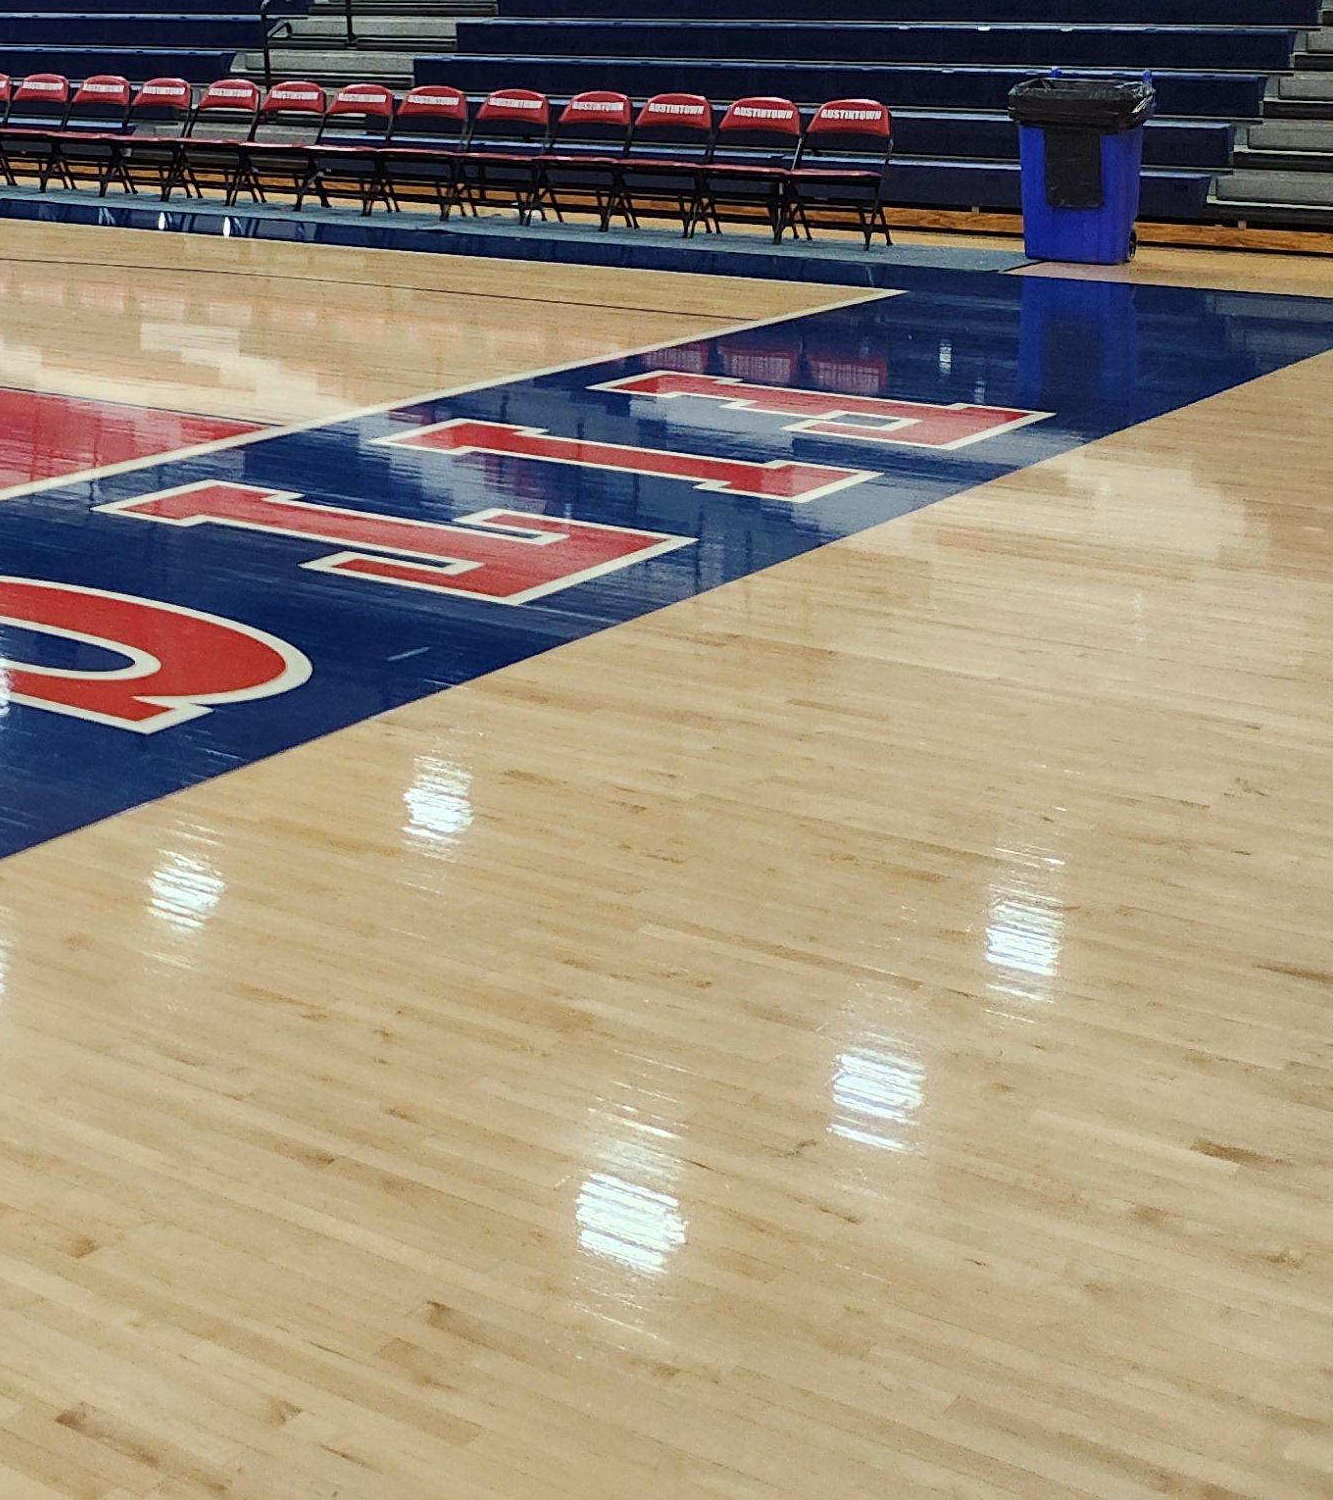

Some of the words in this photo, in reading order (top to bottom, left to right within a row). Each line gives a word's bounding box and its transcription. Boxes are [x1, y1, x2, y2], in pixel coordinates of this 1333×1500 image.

[648, 103, 704, 115] AUSTINTOWN
[733, 106, 793, 119] AUSTINTOWN
[820, 109, 882, 120] AUSTINTOWN
